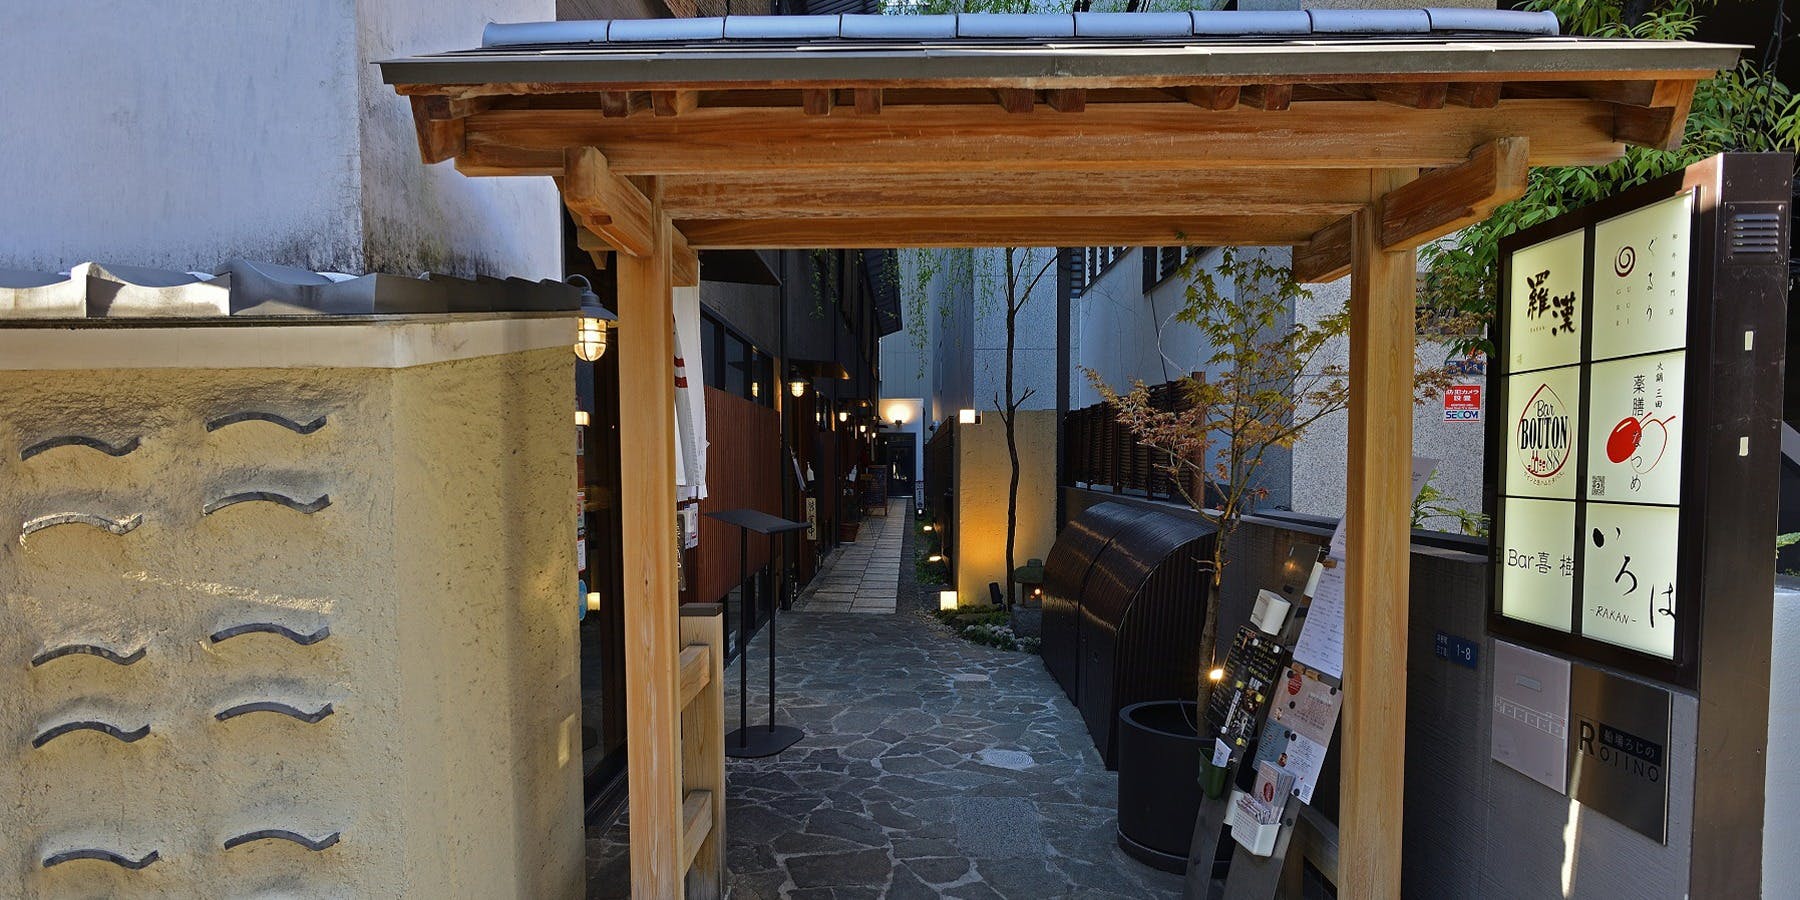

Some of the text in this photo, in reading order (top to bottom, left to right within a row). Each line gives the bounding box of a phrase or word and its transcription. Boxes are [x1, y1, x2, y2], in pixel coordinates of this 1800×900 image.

[1527, 269, 1576, 337] 羅漢
[1446, 410, 1479, 419] SECOM
[1533, 399, 1556, 417] Bar
[1521, 415, 1568, 450] BOUTON
[1630, 374, 1645, 493] 薬膳 なつめ
[1592, 526, 1677, 629] いろは
[1457, 643, 1471, 661] 1-8
